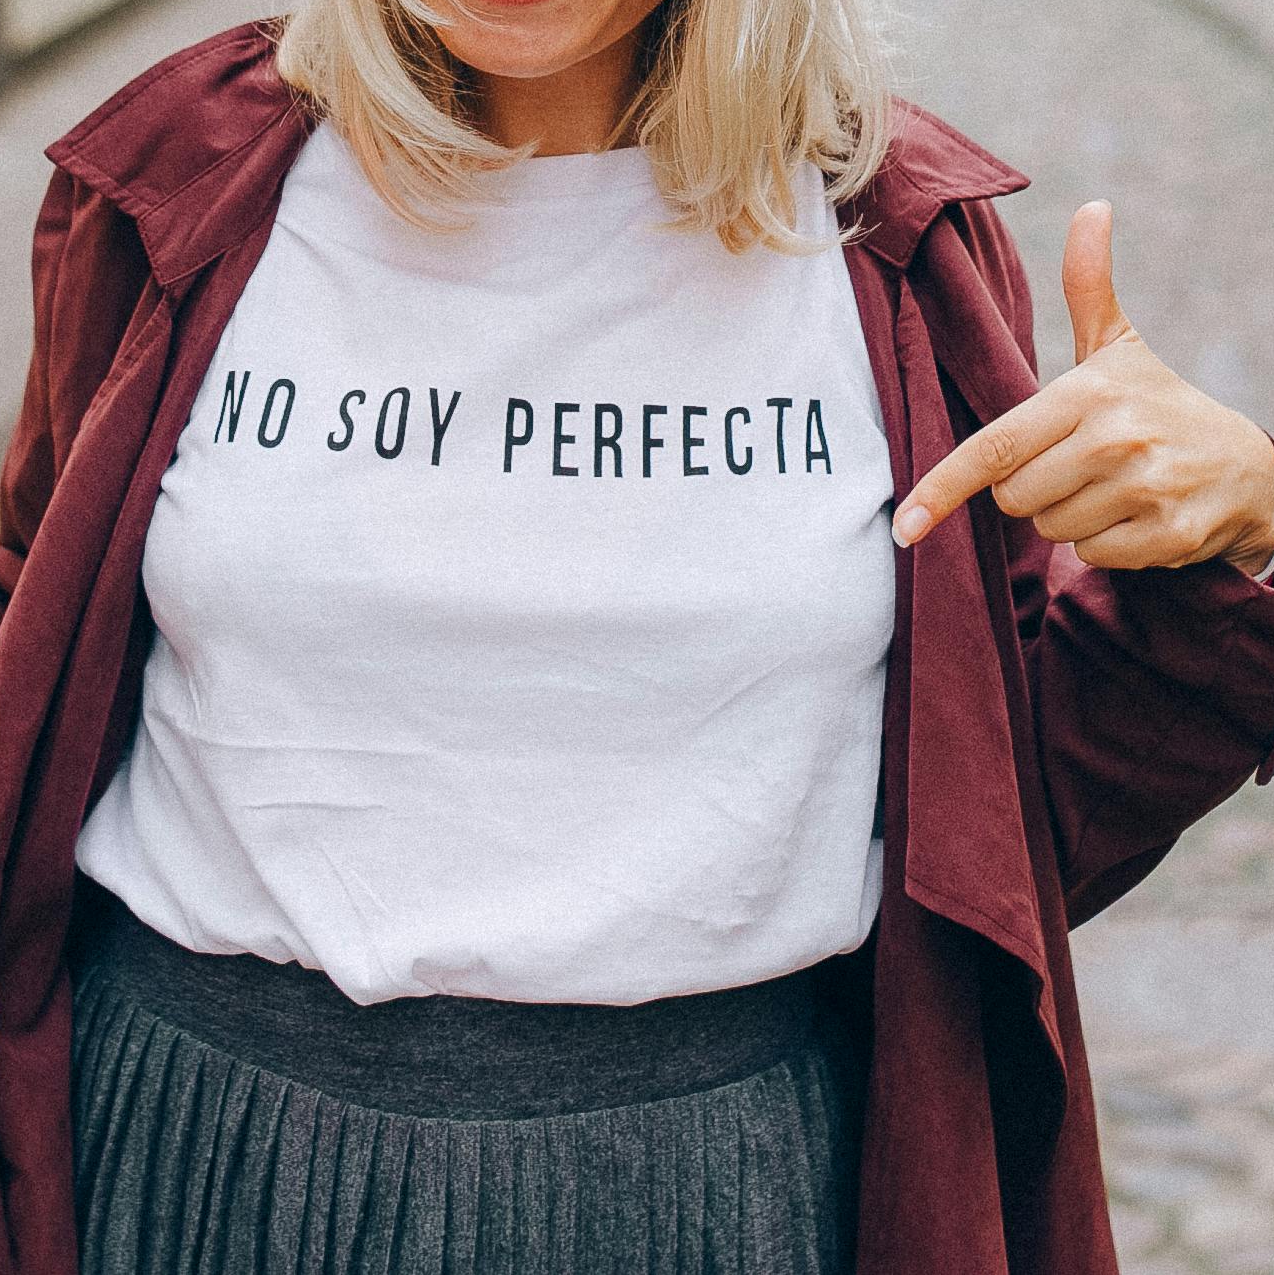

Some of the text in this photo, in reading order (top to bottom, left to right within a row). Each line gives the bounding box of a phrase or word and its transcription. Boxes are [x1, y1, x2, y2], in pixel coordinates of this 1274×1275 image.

[214, 369, 833, 478] NO SOY PERFECTA
